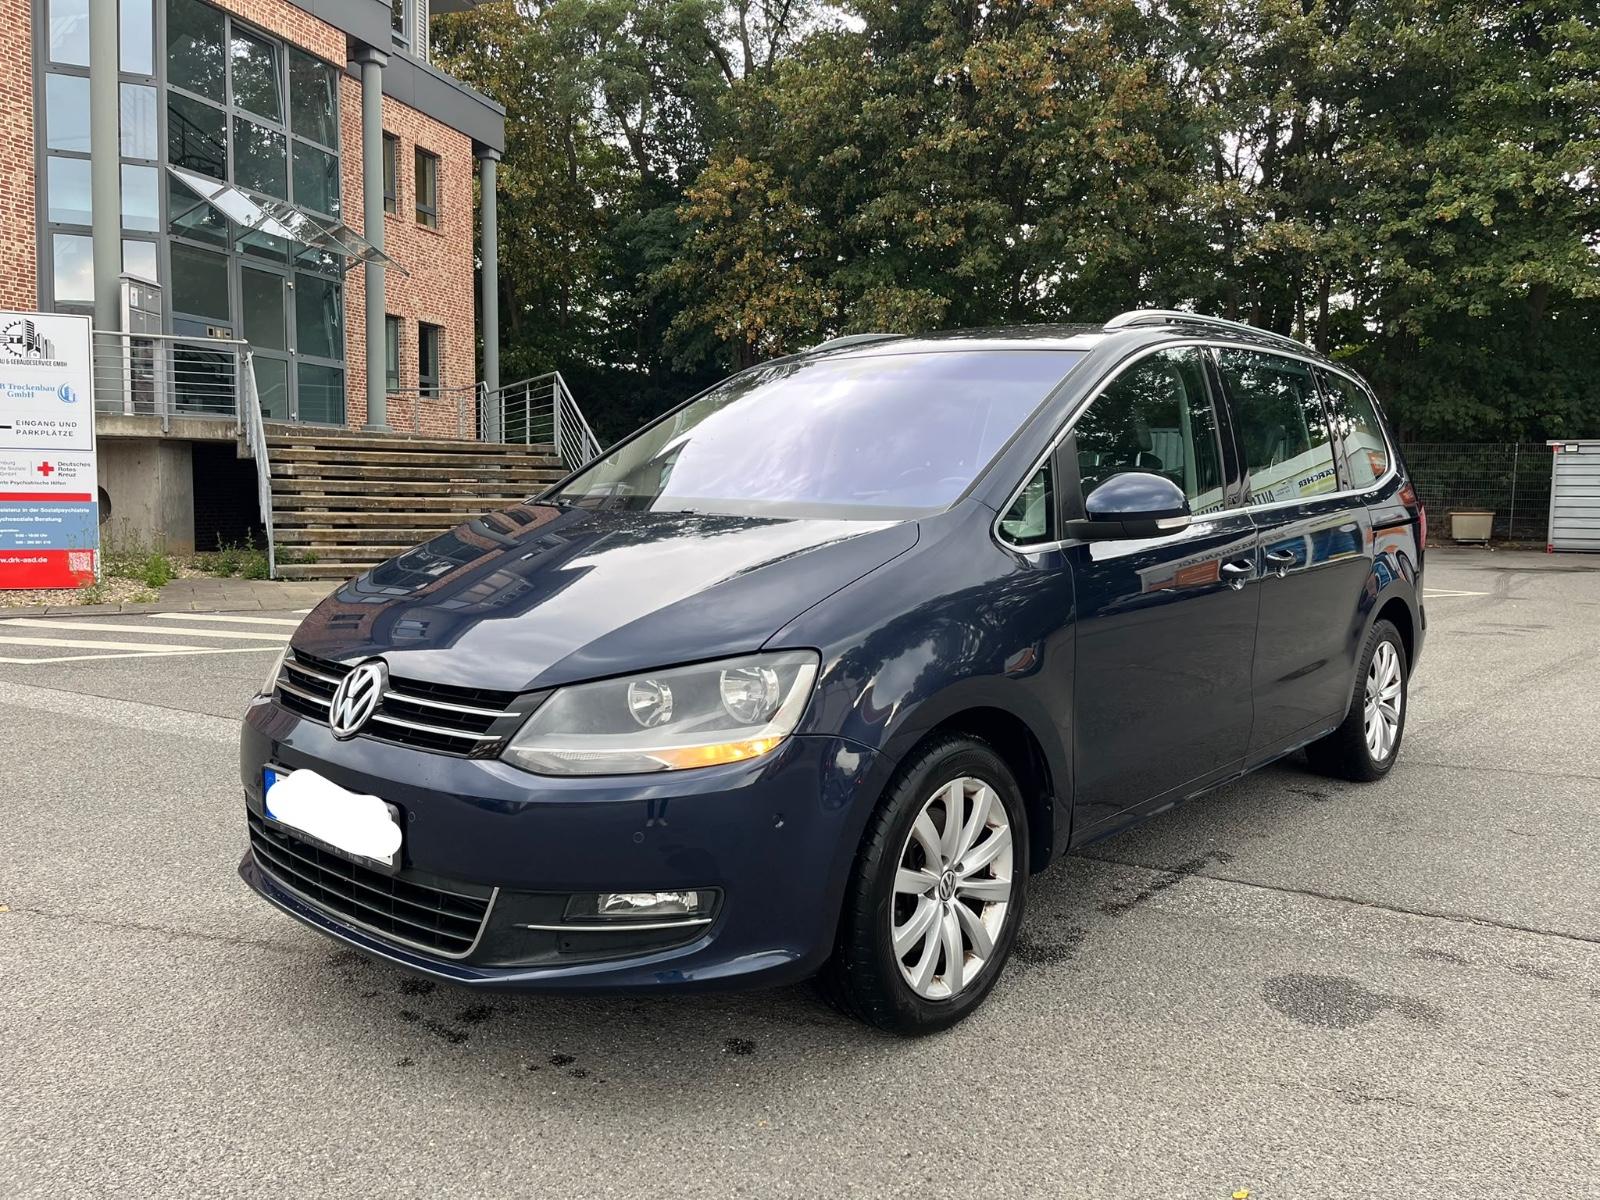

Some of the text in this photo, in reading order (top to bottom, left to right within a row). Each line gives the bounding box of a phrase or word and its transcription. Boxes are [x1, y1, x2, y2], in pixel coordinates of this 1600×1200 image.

[8, 383, 55, 392] Trockenbau
[7, 390, 35, 398] GmbH
[16, 419, 56, 427] EINGANG
[16, 429, 74, 437] PARKPLÄTZE
